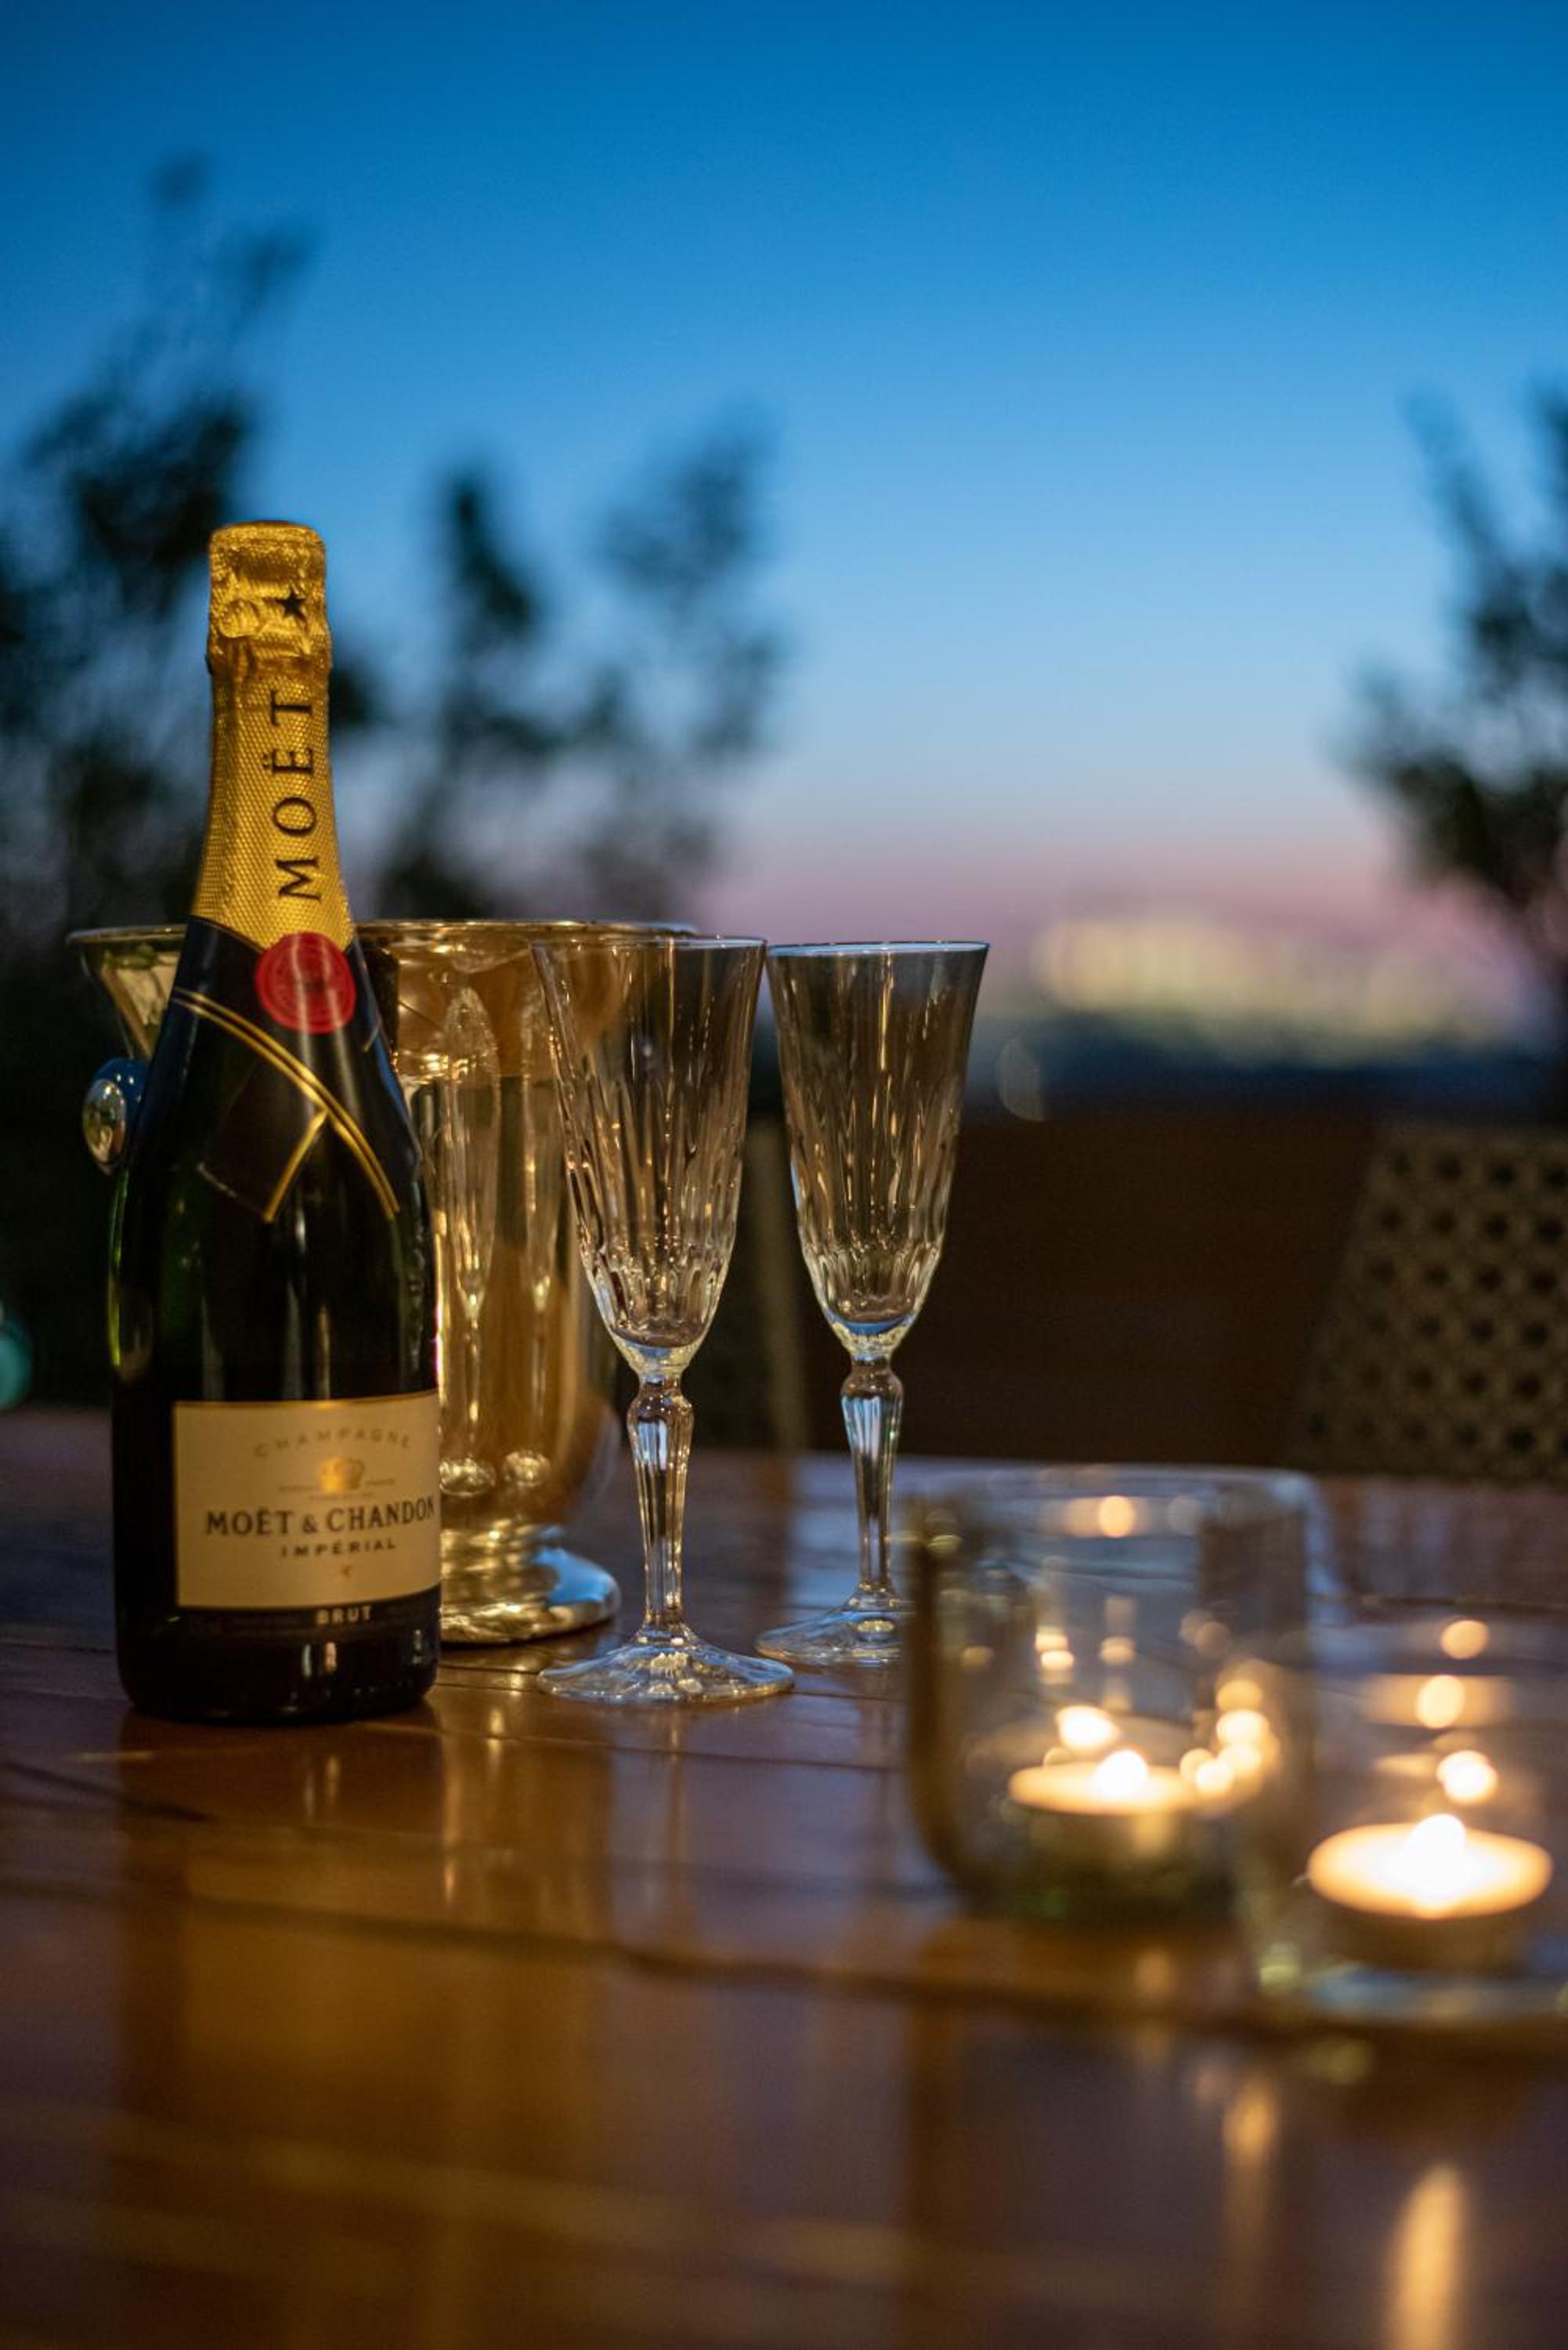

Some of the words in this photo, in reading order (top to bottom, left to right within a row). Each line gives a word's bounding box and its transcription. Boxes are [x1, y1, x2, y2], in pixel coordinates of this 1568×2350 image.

[264, 690, 320, 900] MOËT
[255, 1428, 408, 1457] CHAMPAGNE
[303, 1514, 318, 1533] &
[326, 1495, 434, 1531] CHANDON
[316, 1606, 371, 1625] BRUT
